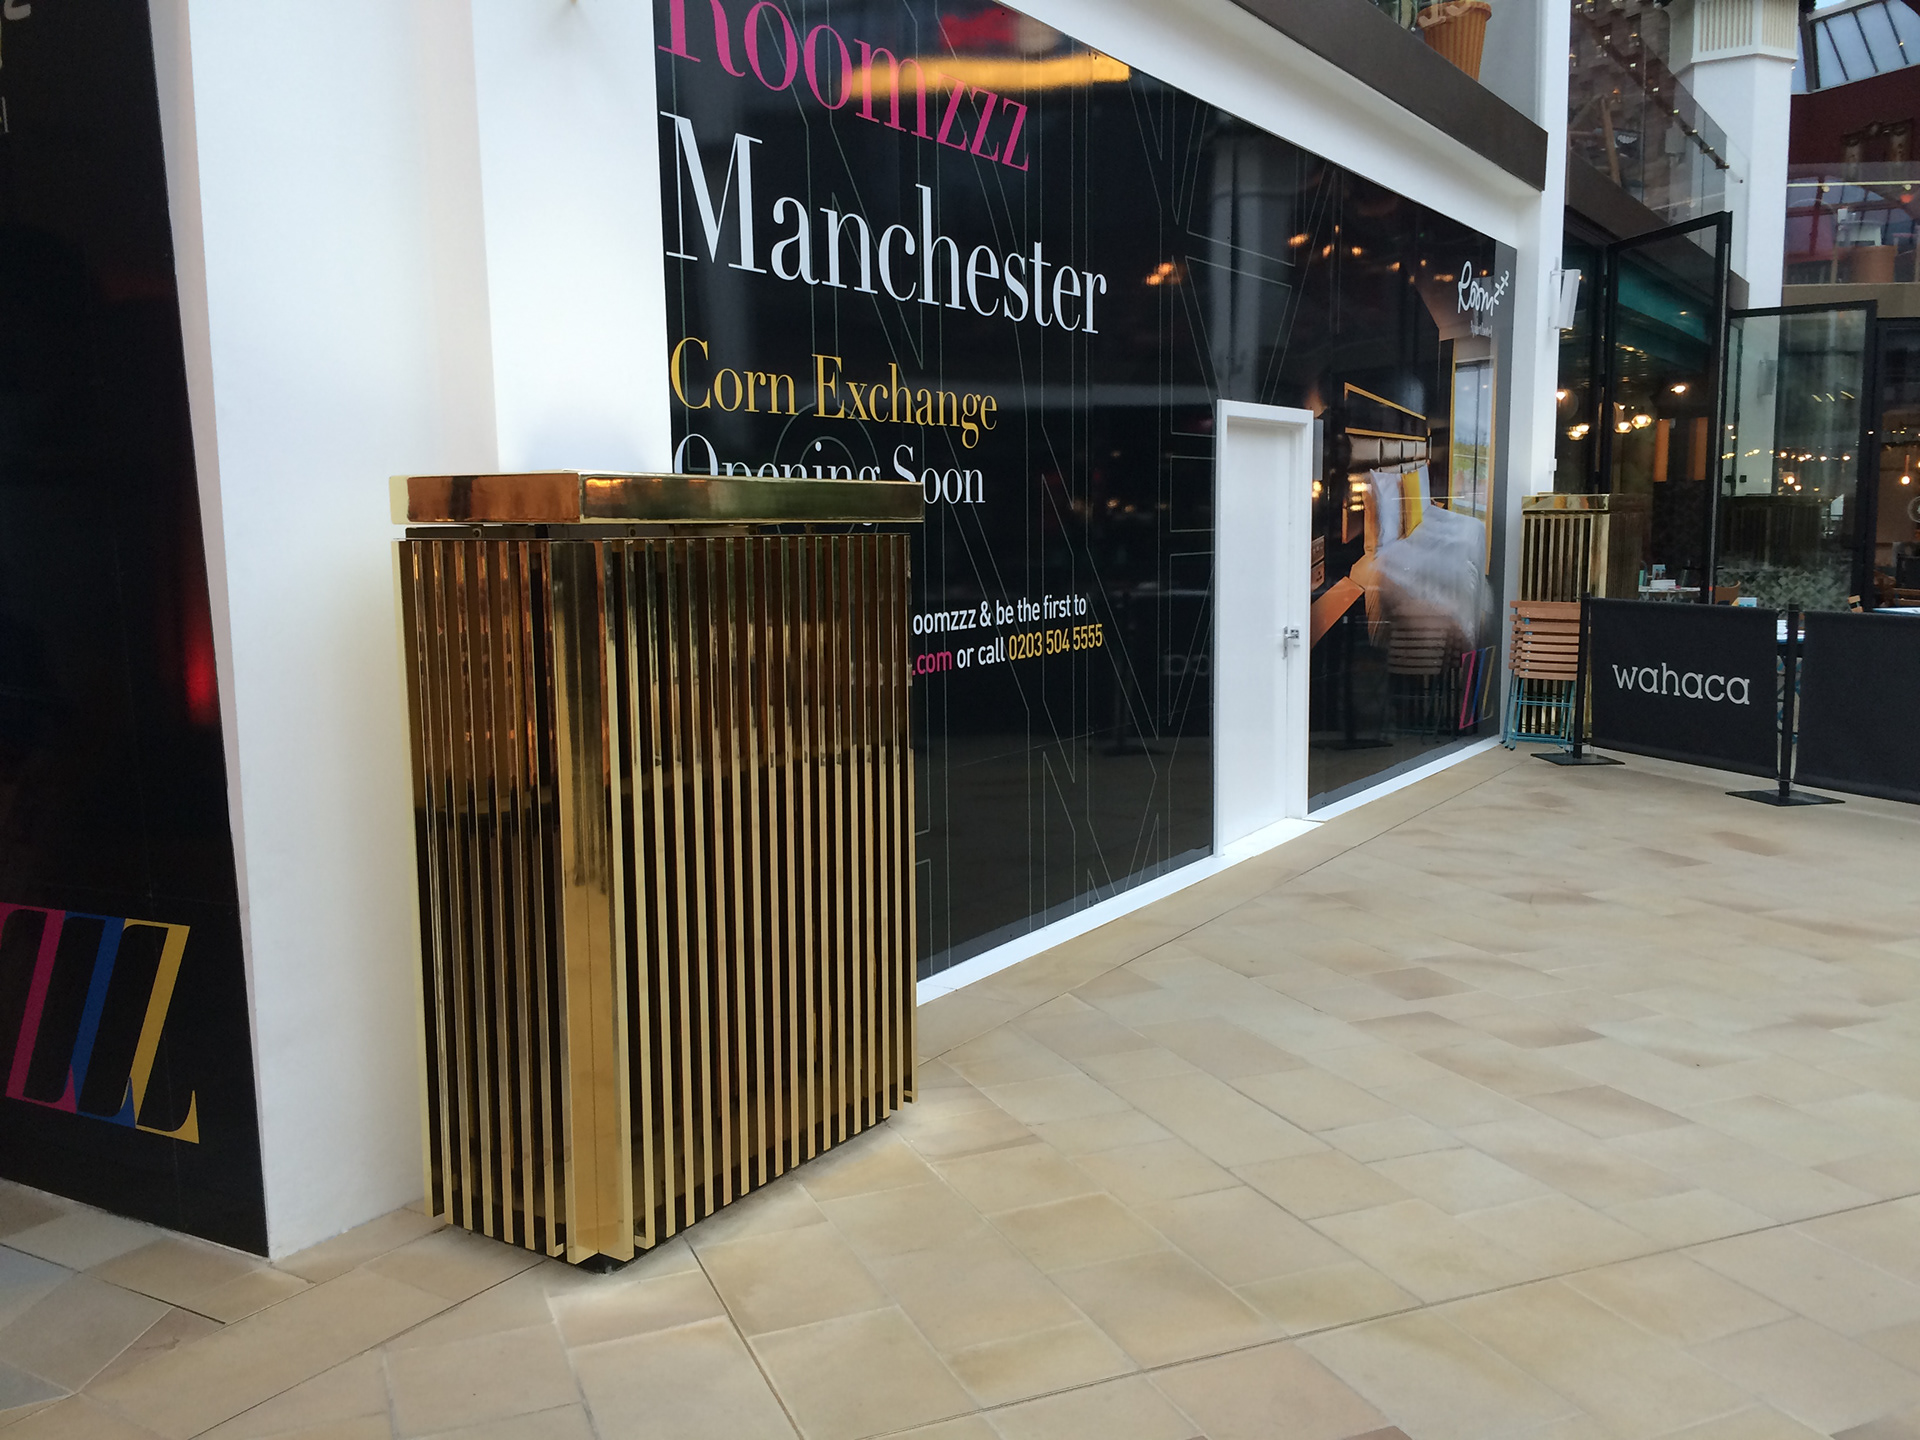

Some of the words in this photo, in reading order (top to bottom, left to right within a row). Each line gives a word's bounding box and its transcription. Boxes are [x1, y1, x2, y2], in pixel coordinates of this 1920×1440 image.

[660, 111, 1107, 334] Manchester
[671, 337, 798, 415] Corn
[811, 354, 998, 449] Exchange
[893, 444, 986, 504] Soon
[913, 609, 977, 635] oomzzz
[979, 601, 992, 627] &
[996, 600, 1014, 625] be
[1017, 597, 1040, 623] the
[1043, 595, 1071, 619] first
[1074, 594, 1087, 616] to
[957, 647, 975, 669] or
[978, 636, 1006, 665] call
[1008, 632, 1043, 661] 0203
[1046, 628, 1071, 655] 504
[1073, 624, 1103, 649] 5555
[1612, 662, 1750, 705] wahaca
